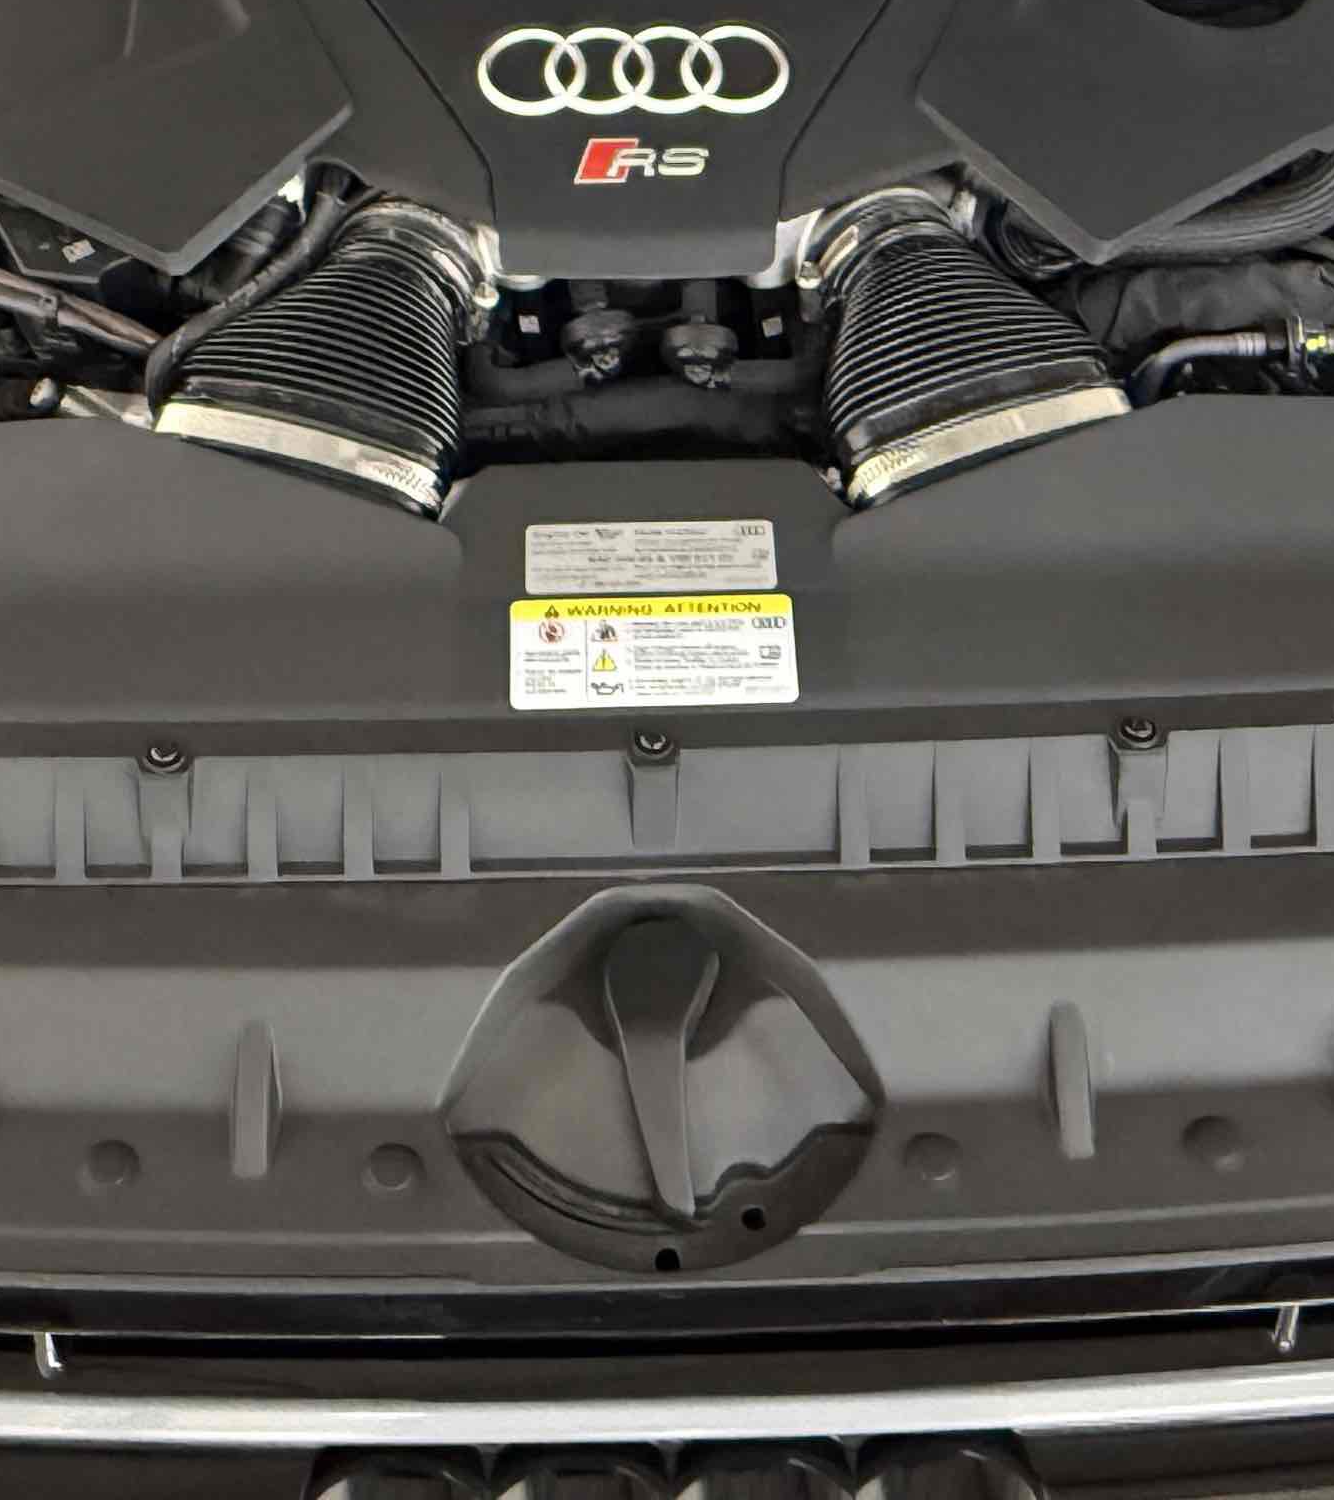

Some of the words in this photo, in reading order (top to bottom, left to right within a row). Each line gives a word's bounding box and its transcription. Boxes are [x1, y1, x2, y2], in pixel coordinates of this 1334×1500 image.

[604, 144, 711, 179] RS
[567, 603, 653, 617] WARNING
[664, 601, 763, 614] ATTENTION
